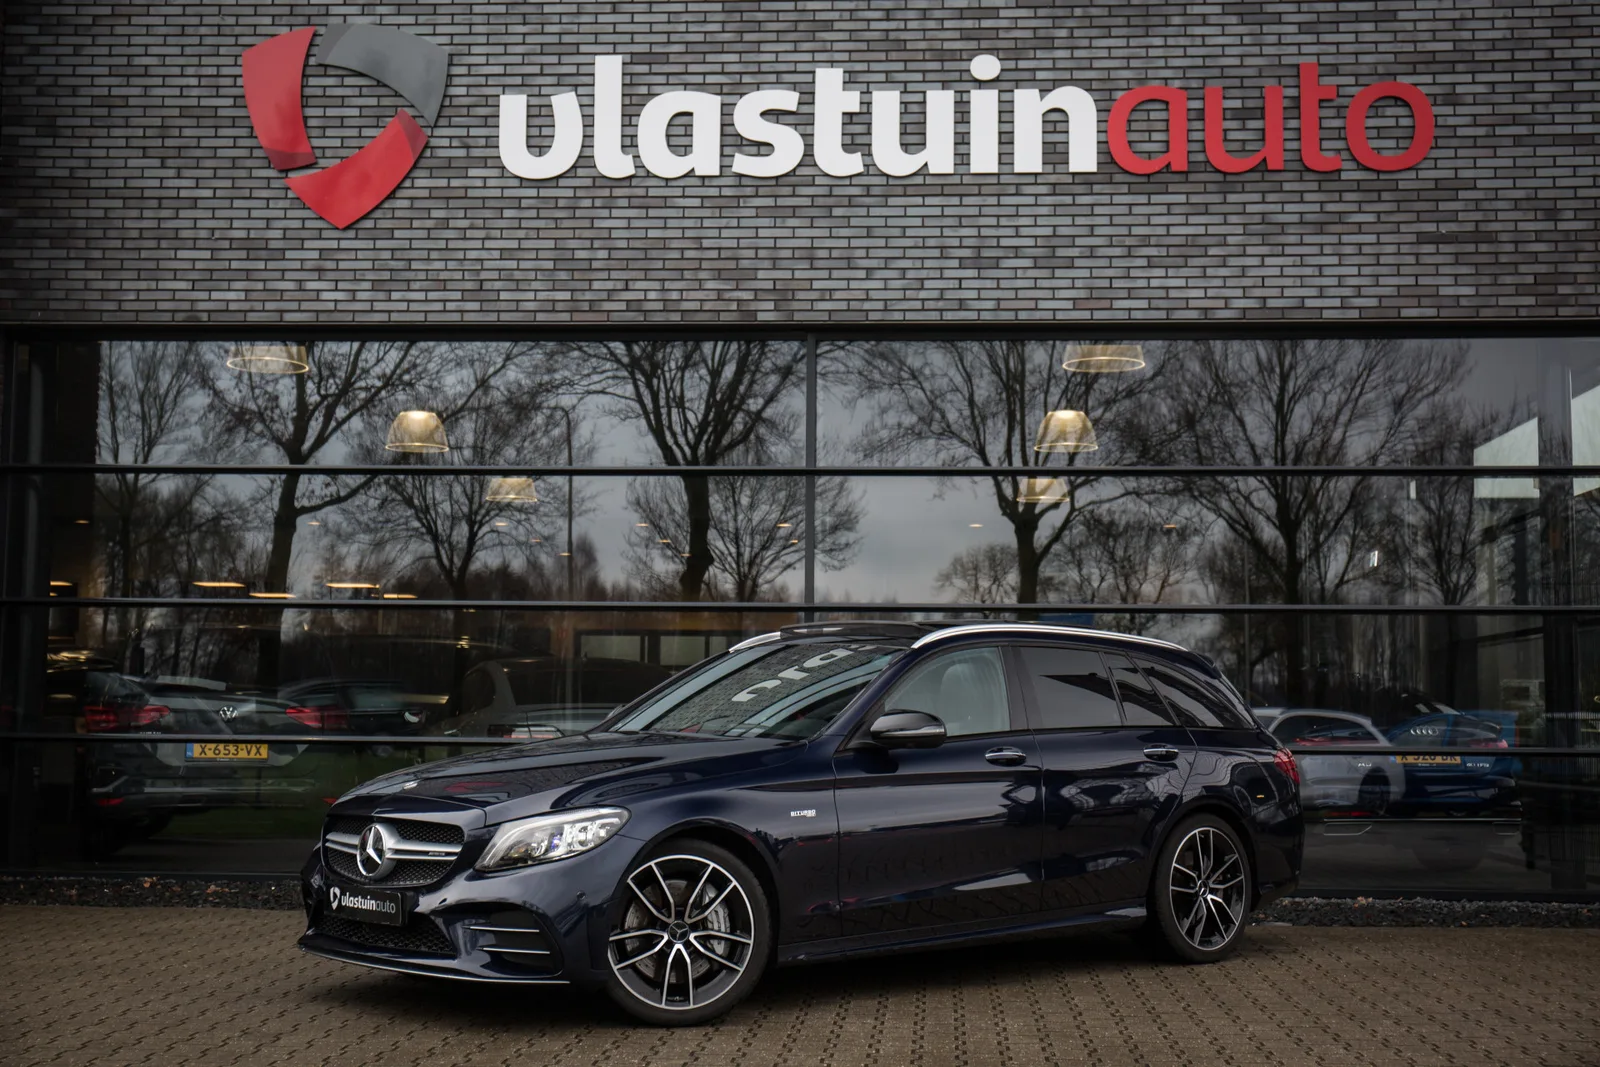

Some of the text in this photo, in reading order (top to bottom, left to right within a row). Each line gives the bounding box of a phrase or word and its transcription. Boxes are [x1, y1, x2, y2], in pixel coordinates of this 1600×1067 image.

[498, 54, 1435, 179] vlastuinauto
[199, 744, 263, 757] X-653-VX
[341, 891, 397, 914] vlastuinauto
